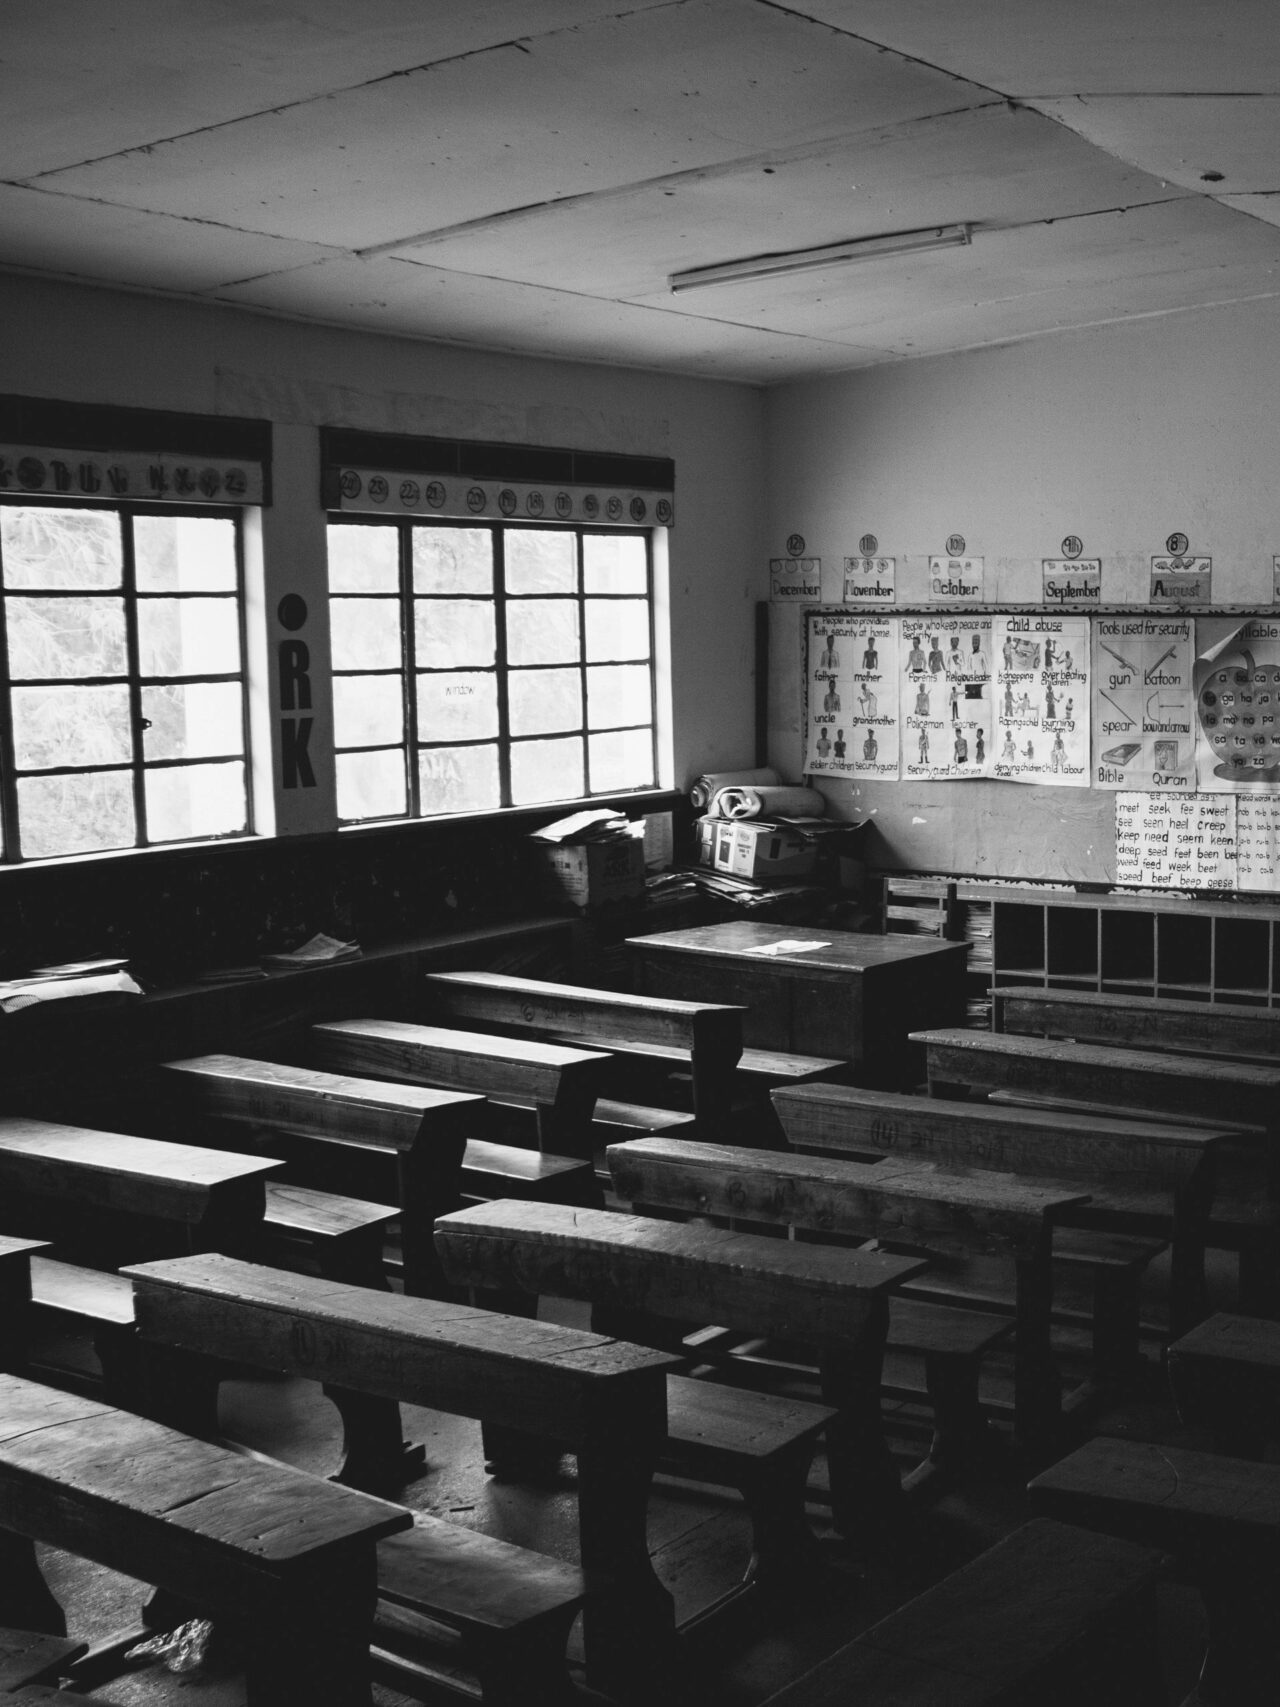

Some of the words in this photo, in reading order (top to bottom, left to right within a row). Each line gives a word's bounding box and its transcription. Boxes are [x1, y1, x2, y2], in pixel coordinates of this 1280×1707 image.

[773, 579, 821, 596] December
[846, 580, 894, 596] November
[933, 578, 979, 596] October
[1046, 581, 1099, 603] September
[1153, 580, 1200, 600] August
[1035, 617, 1062, 631] abuse
[1097, 621, 1120, 636] Tools
[1122, 620, 1143, 636] used
[1145, 620, 1157, 636] for
[1159, 622, 1190, 641] security
[814, 670, 838, 682] father
[854, 671, 882, 682] mother
[908, 672, 937, 683] Parents
[1061, 669, 1086, 683] beating
[1109, 675, 1131, 690] gun
[1144, 670, 1181, 685] batoon
[814, 712, 835, 723] uncle
[853, 716, 897, 727] grandmother
[907, 717, 944, 729] Policeman
[1042, 718, 1075, 730] burning
[1102, 721, 1131, 735] spear
[1062, 764, 1084, 774] labour
[1098, 767, 1124, 783] Bible
[1153, 772, 1187, 786] Quran
[1149, 802, 1171, 814] seek
[1181, 803, 1194, 814] fee
[1200, 804, 1230, 816] sweet
[1169, 818, 1188, 829] heel
[1197, 821, 1226, 835] creep
[1117, 828, 1140, 843] keep
[1145, 830, 1169, 843] need
[1177, 834, 1203, 844] seem
[1210, 834, 1234, 845] keen
[1119, 843, 1141, 858] deep
[1148, 846, 1167, 856] seed
[1174, 848, 1192, 859] feet
[1197, 847, 1219, 859] been
[1169, 861, 1191, 872] week
[1198, 862, 1217, 873] beet
[1152, 872, 1174, 883] beef
[1180, 874, 1201, 886] beep
[1207, 879, 1233, 888] geese
